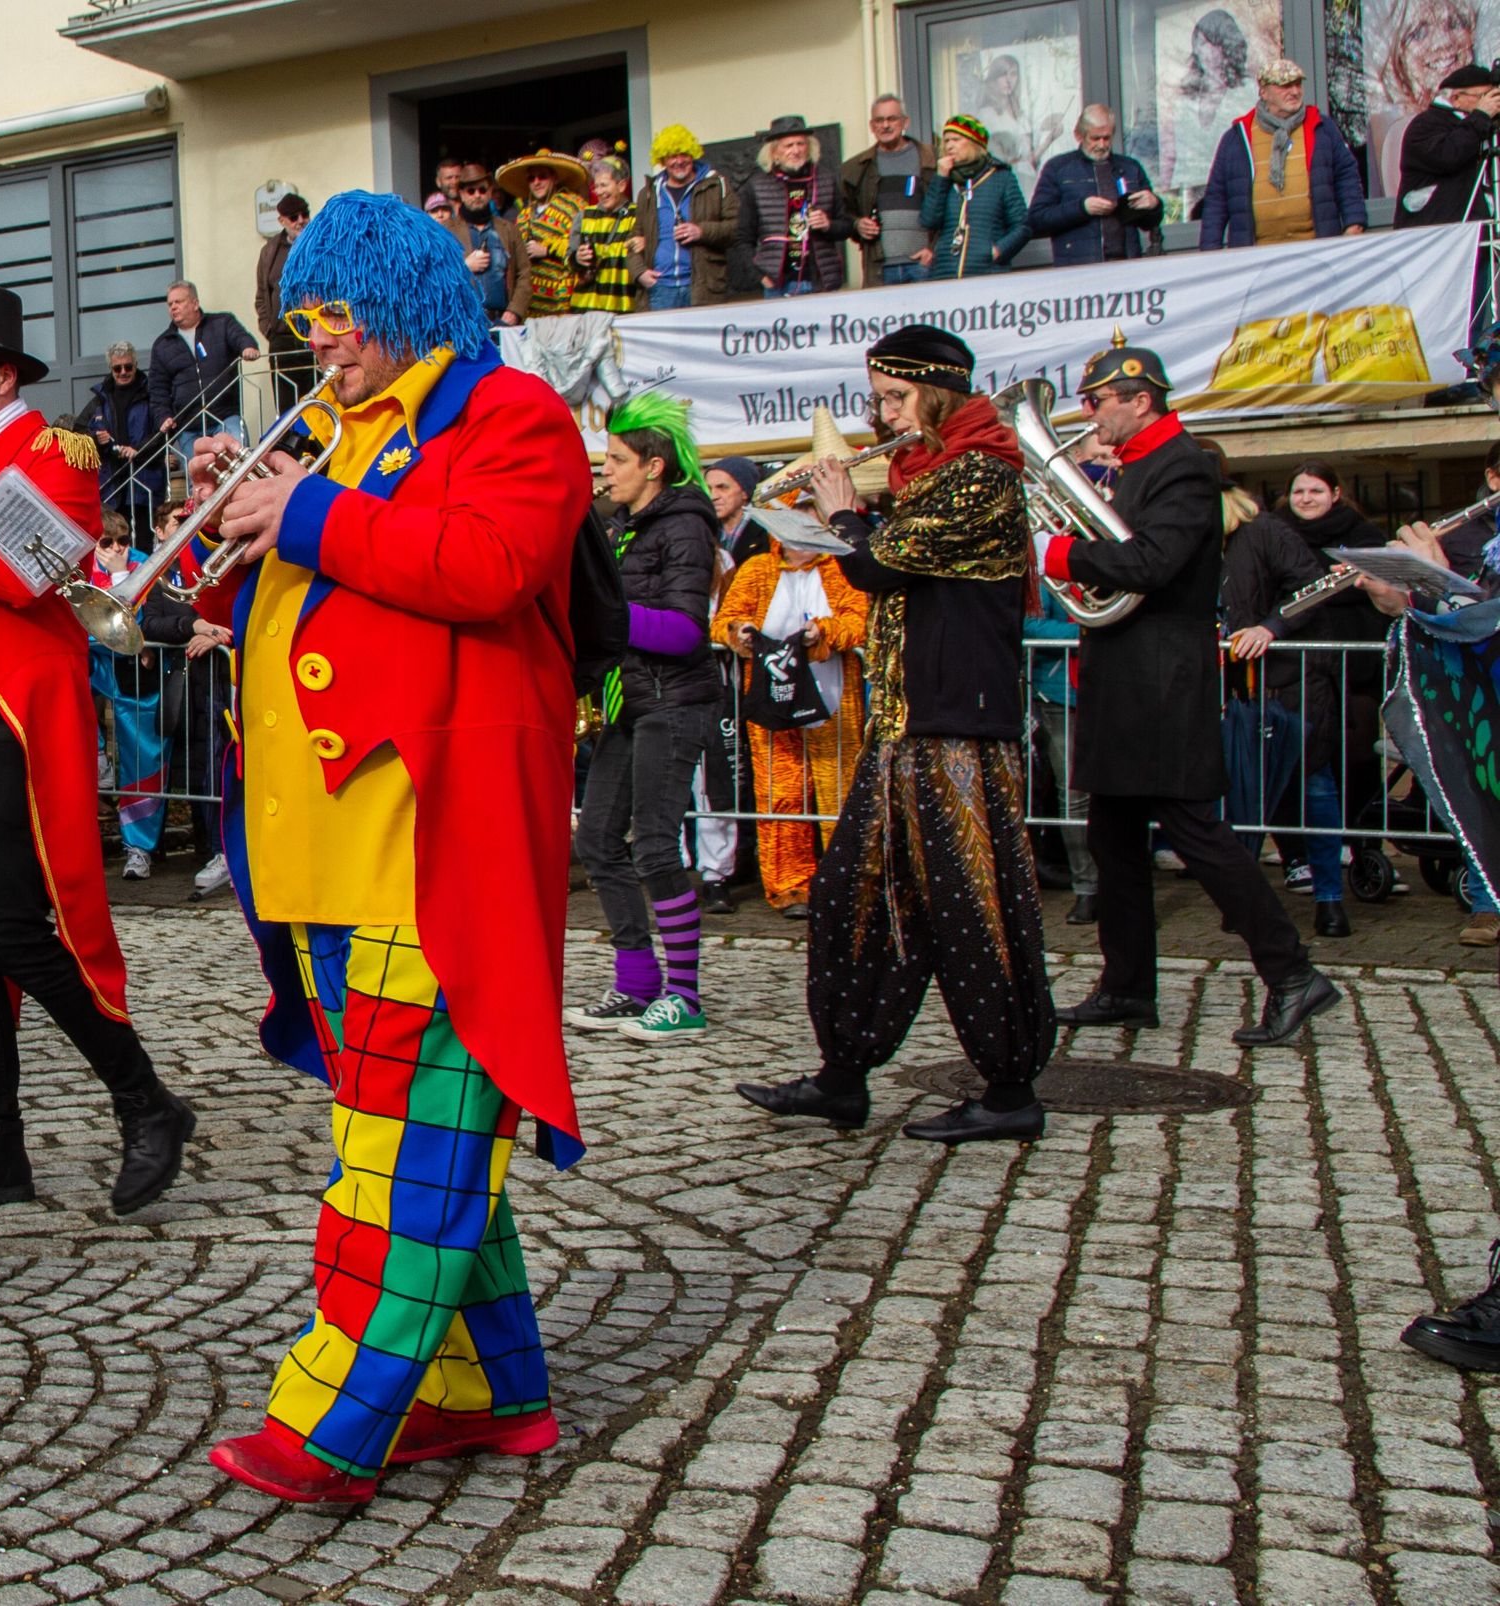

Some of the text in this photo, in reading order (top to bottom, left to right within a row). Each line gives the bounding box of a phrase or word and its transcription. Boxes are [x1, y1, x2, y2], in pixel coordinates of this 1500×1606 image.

[721, 286, 1167, 357] Großer Rosenmontagsumzug
[738, 381, 869, 426] Wallendo
